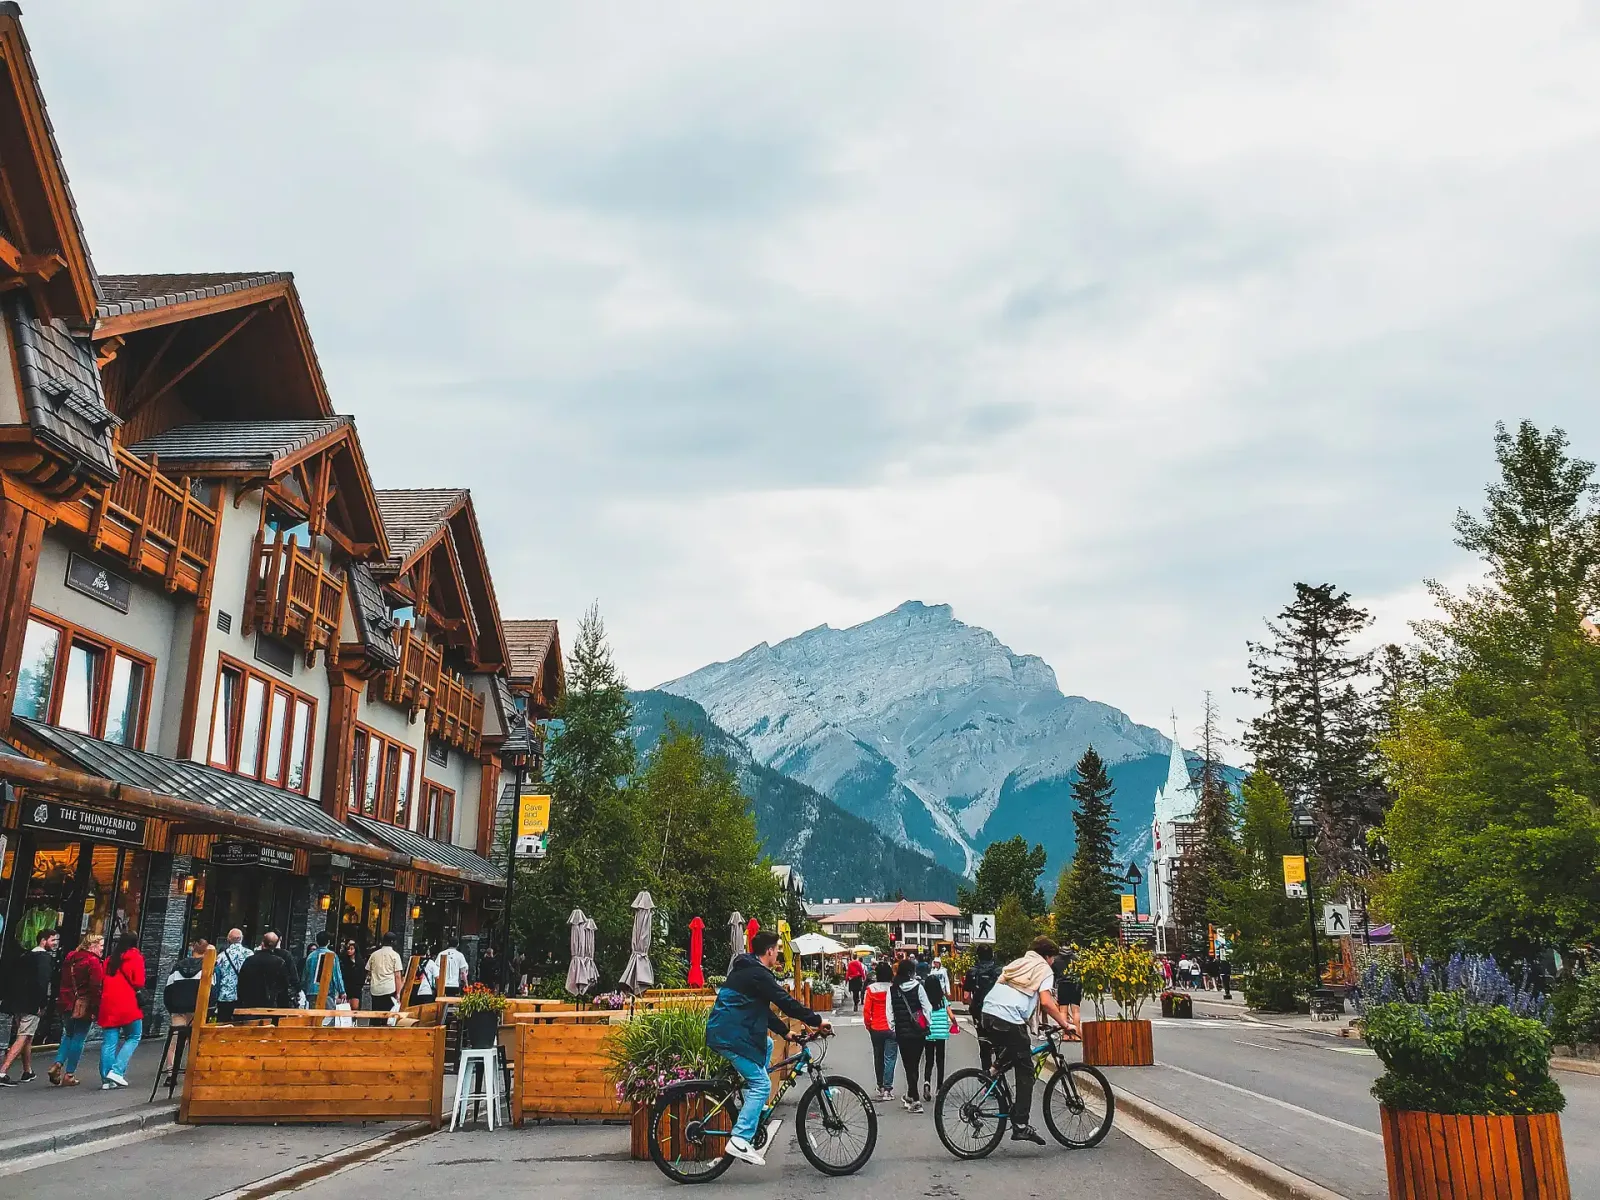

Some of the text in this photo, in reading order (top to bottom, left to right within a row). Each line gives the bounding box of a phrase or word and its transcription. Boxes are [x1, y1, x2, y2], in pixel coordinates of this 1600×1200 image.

[524, 803, 543, 811] Cave
[60, 808, 137, 831] THE THUNDERBIRD
